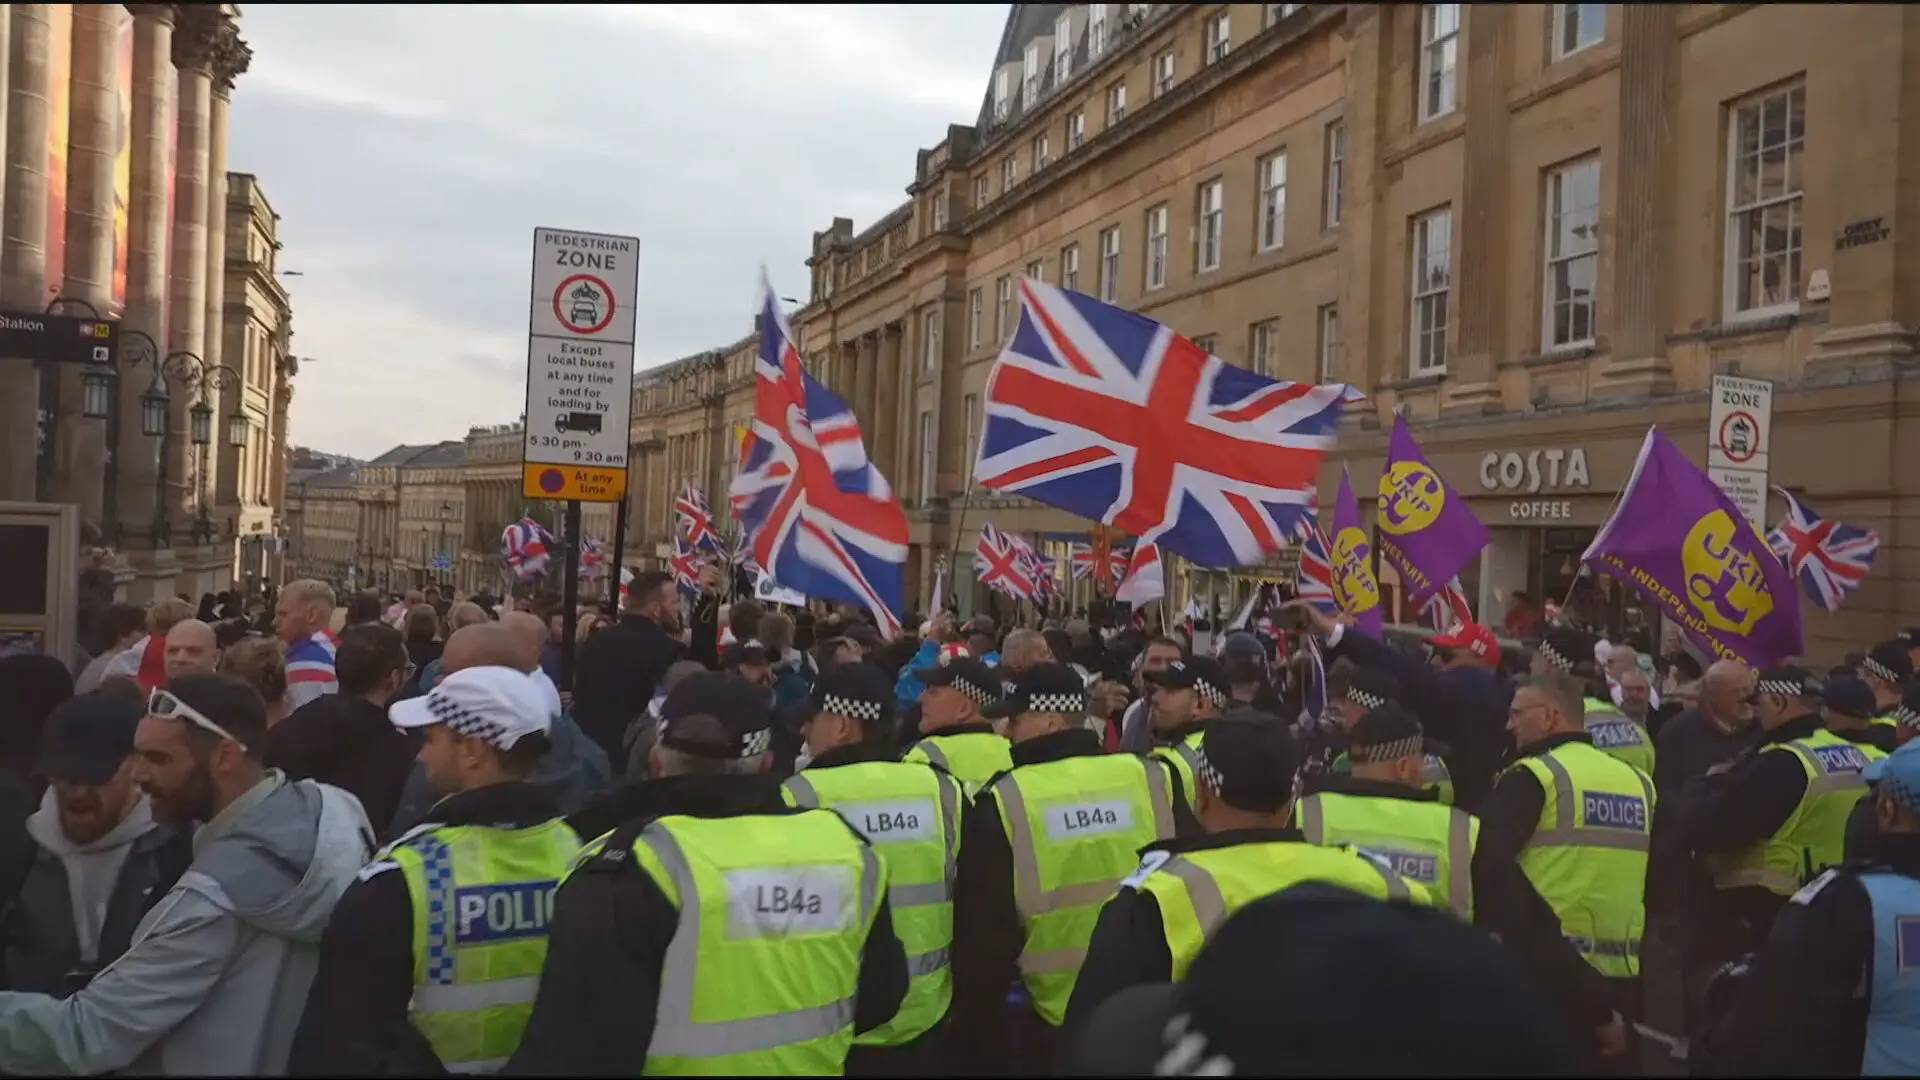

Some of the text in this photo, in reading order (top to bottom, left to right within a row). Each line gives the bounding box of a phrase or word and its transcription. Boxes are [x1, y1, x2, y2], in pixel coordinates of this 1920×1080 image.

[545, 233, 630, 252] PEDESTRIAN
[556, 249, 616, 270] ZONE
[0, 315, 44, 331] Station
[561, 343, 603, 356] Except
[547, 354, 615, 369] local buses
[547, 370, 614, 384] at any time
[1715, 378, 1769, 393] PEDESTRIAN
[558, 386, 601, 398] and for
[1722, 391, 1761, 409] ZONE
[548, 397, 610, 412] loading by
[530, 435, 560, 447] 5.30
[573, 451, 624, 464] 9.30 am
[574, 471, 613, 484] At any
[1480, 447, 1590, 493] COSTA
[579, 484, 606, 495] time
[1389, 471, 1432, 512] UKIP
[1510, 501, 1572, 518] COFFEE
[1338, 540, 1376, 593] UKIP
[1702, 532, 1773, 596] UKIP
[1630, 567, 1748, 665] INDEPENDNC
[1063, 807, 1117, 831] LB4a
[1586, 797, 1645, 826] POLICE
[865, 811, 920, 834] LB4a
[756, 885, 822, 915] LB4a
